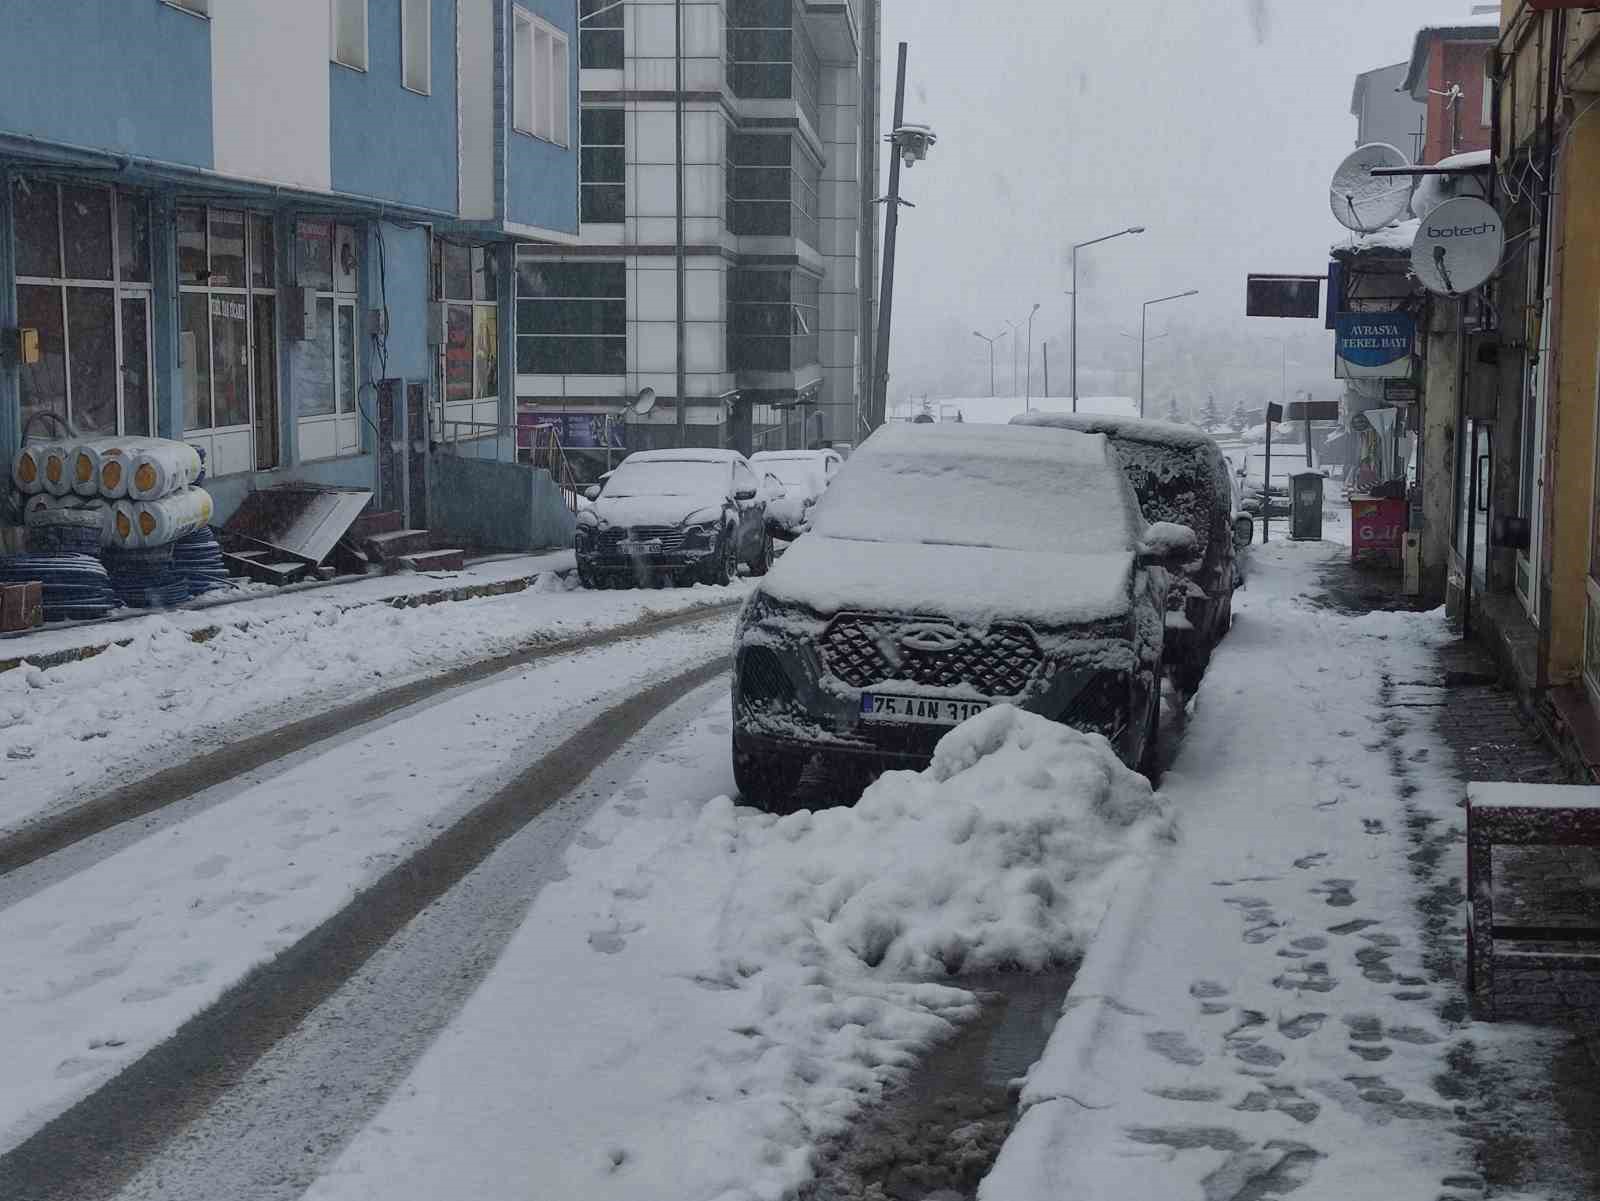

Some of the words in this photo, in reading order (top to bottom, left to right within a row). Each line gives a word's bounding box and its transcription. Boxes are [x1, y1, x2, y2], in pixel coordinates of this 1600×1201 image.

[1427, 221, 1496, 238] botech
[1350, 324, 1400, 336] AVRASYA
[1342, 337, 1380, 348] TEKEL
[874, 697, 896, 714] 75
[905, 700, 939, 719] AAN
